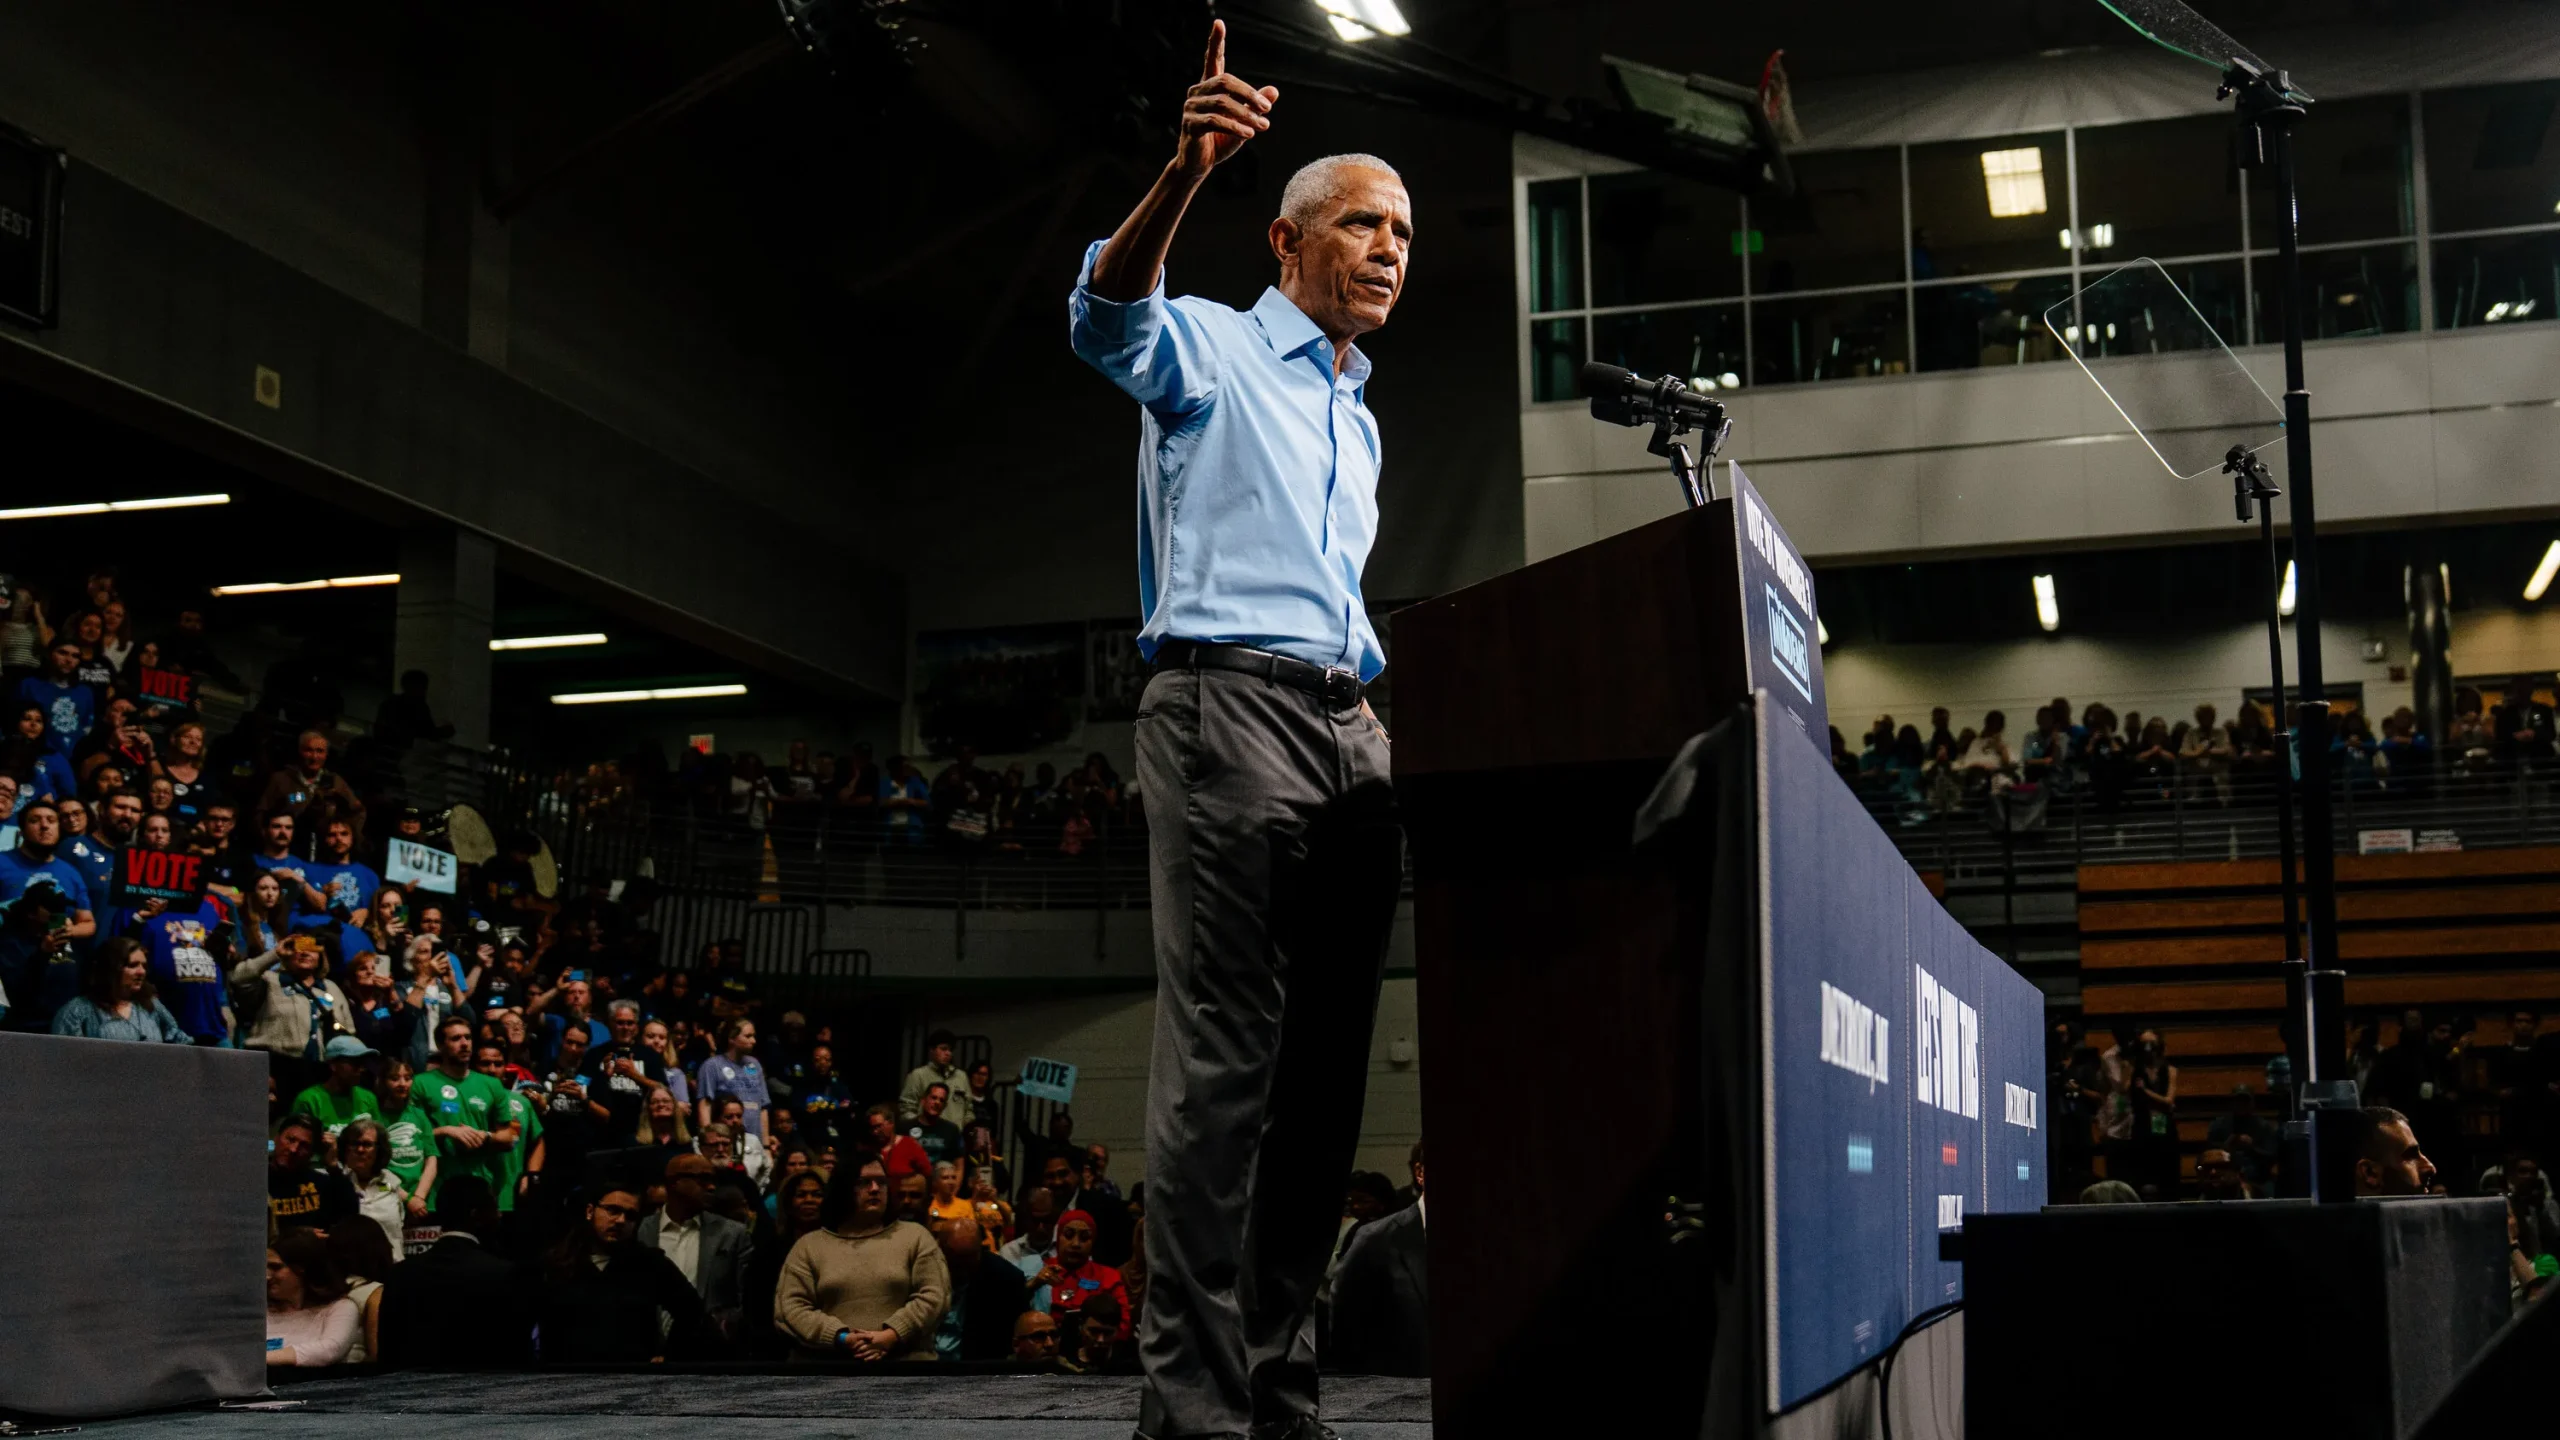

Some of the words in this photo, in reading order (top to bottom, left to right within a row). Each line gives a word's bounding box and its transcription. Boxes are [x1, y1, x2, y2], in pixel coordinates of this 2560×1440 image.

[1744, 490, 1766, 558] VOTE
[1763, 515, 1775, 570] BY
[1773, 530, 1808, 616] NOVEMBER
[140, 666, 191, 703] VOTE
[126, 847, 203, 893] VOTE
[400, 842, 448, 877] VOTE
[1820, 980, 1875, 1096] DETROIT,
[1874, 1013, 1889, 1085] MI
[1916, 963, 1940, 1110] LET'S
[1940, 985, 1960, 1115] WIN
[1959, 1000, 1979, 1121] THIS
[1026, 1059, 1070, 1087] VOTE
[2005, 1081, 2031, 1137] DETROIT,
[2030, 1091, 2037, 1129] MI
